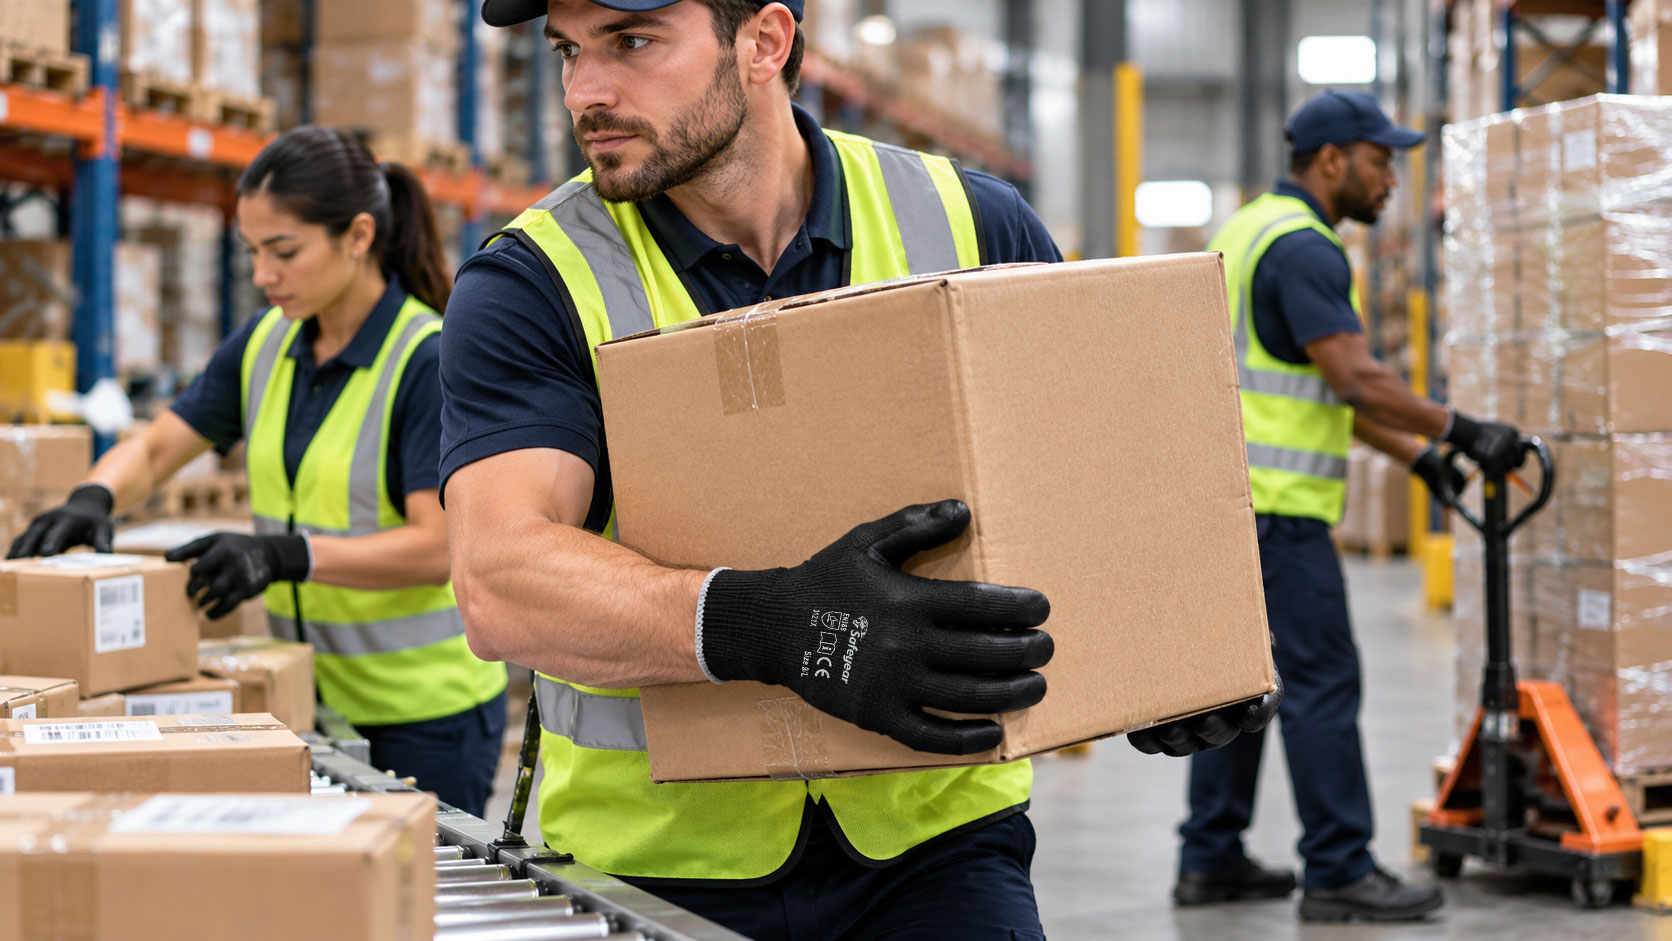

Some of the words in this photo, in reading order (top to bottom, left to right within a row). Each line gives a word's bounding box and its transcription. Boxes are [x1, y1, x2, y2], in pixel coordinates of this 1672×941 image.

[802, 650, 812, 665] Size
[814, 656, 832, 679] CE
[841, 629, 860, 684] Safeyear
